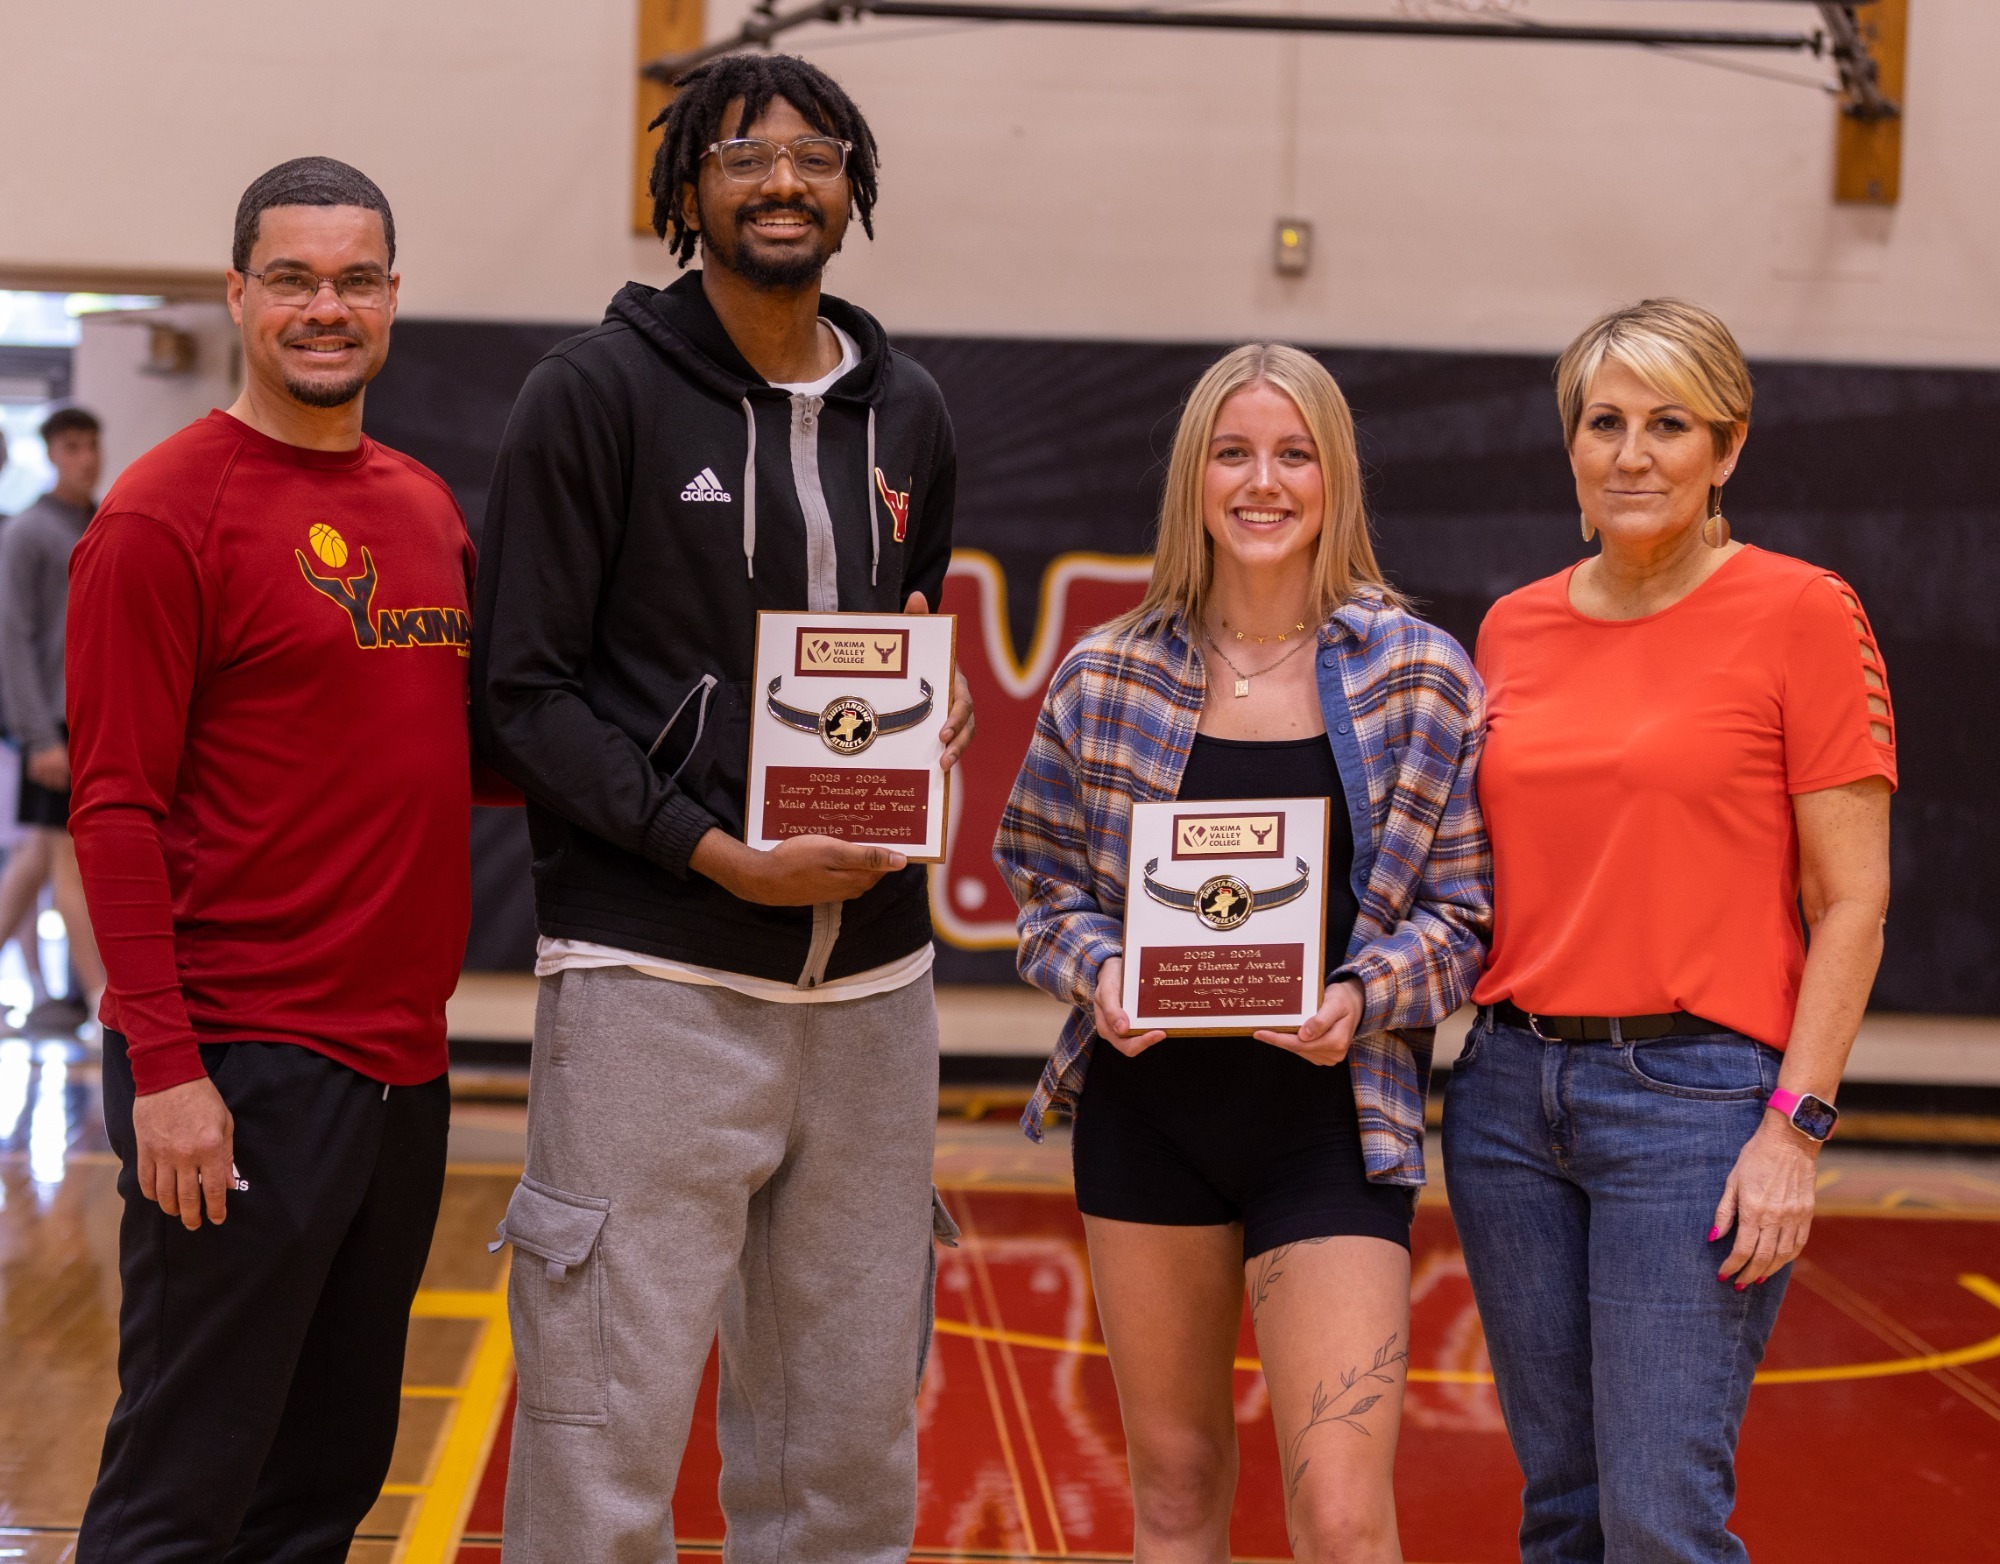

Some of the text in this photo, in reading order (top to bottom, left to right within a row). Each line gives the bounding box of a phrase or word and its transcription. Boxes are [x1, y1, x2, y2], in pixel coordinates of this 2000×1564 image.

[681, 489, 731, 502] adidas
[832, 656, 865, 664] COLLEGE
[826, 702, 872, 722] OUTSTANDING
[830, 737, 864, 748] ATHLETE
[855, 774, 887, 784] 2024
[780, 784, 916, 798] Larry Densley Award
[778, 799, 916, 812] Male Athlete of the Year
[779, 823, 912, 837] Javonte Darrett
[1209, 839, 1241, 847] COLLEGE
[1230, 949, 1262, 959] 2024
[1158, 962, 1194, 973] Mary
[1244, 960, 1286, 970] Award
[1152, 974, 1291, 987] Female Athlete of the Year
[1158, 999, 1211, 1011] Brynn
